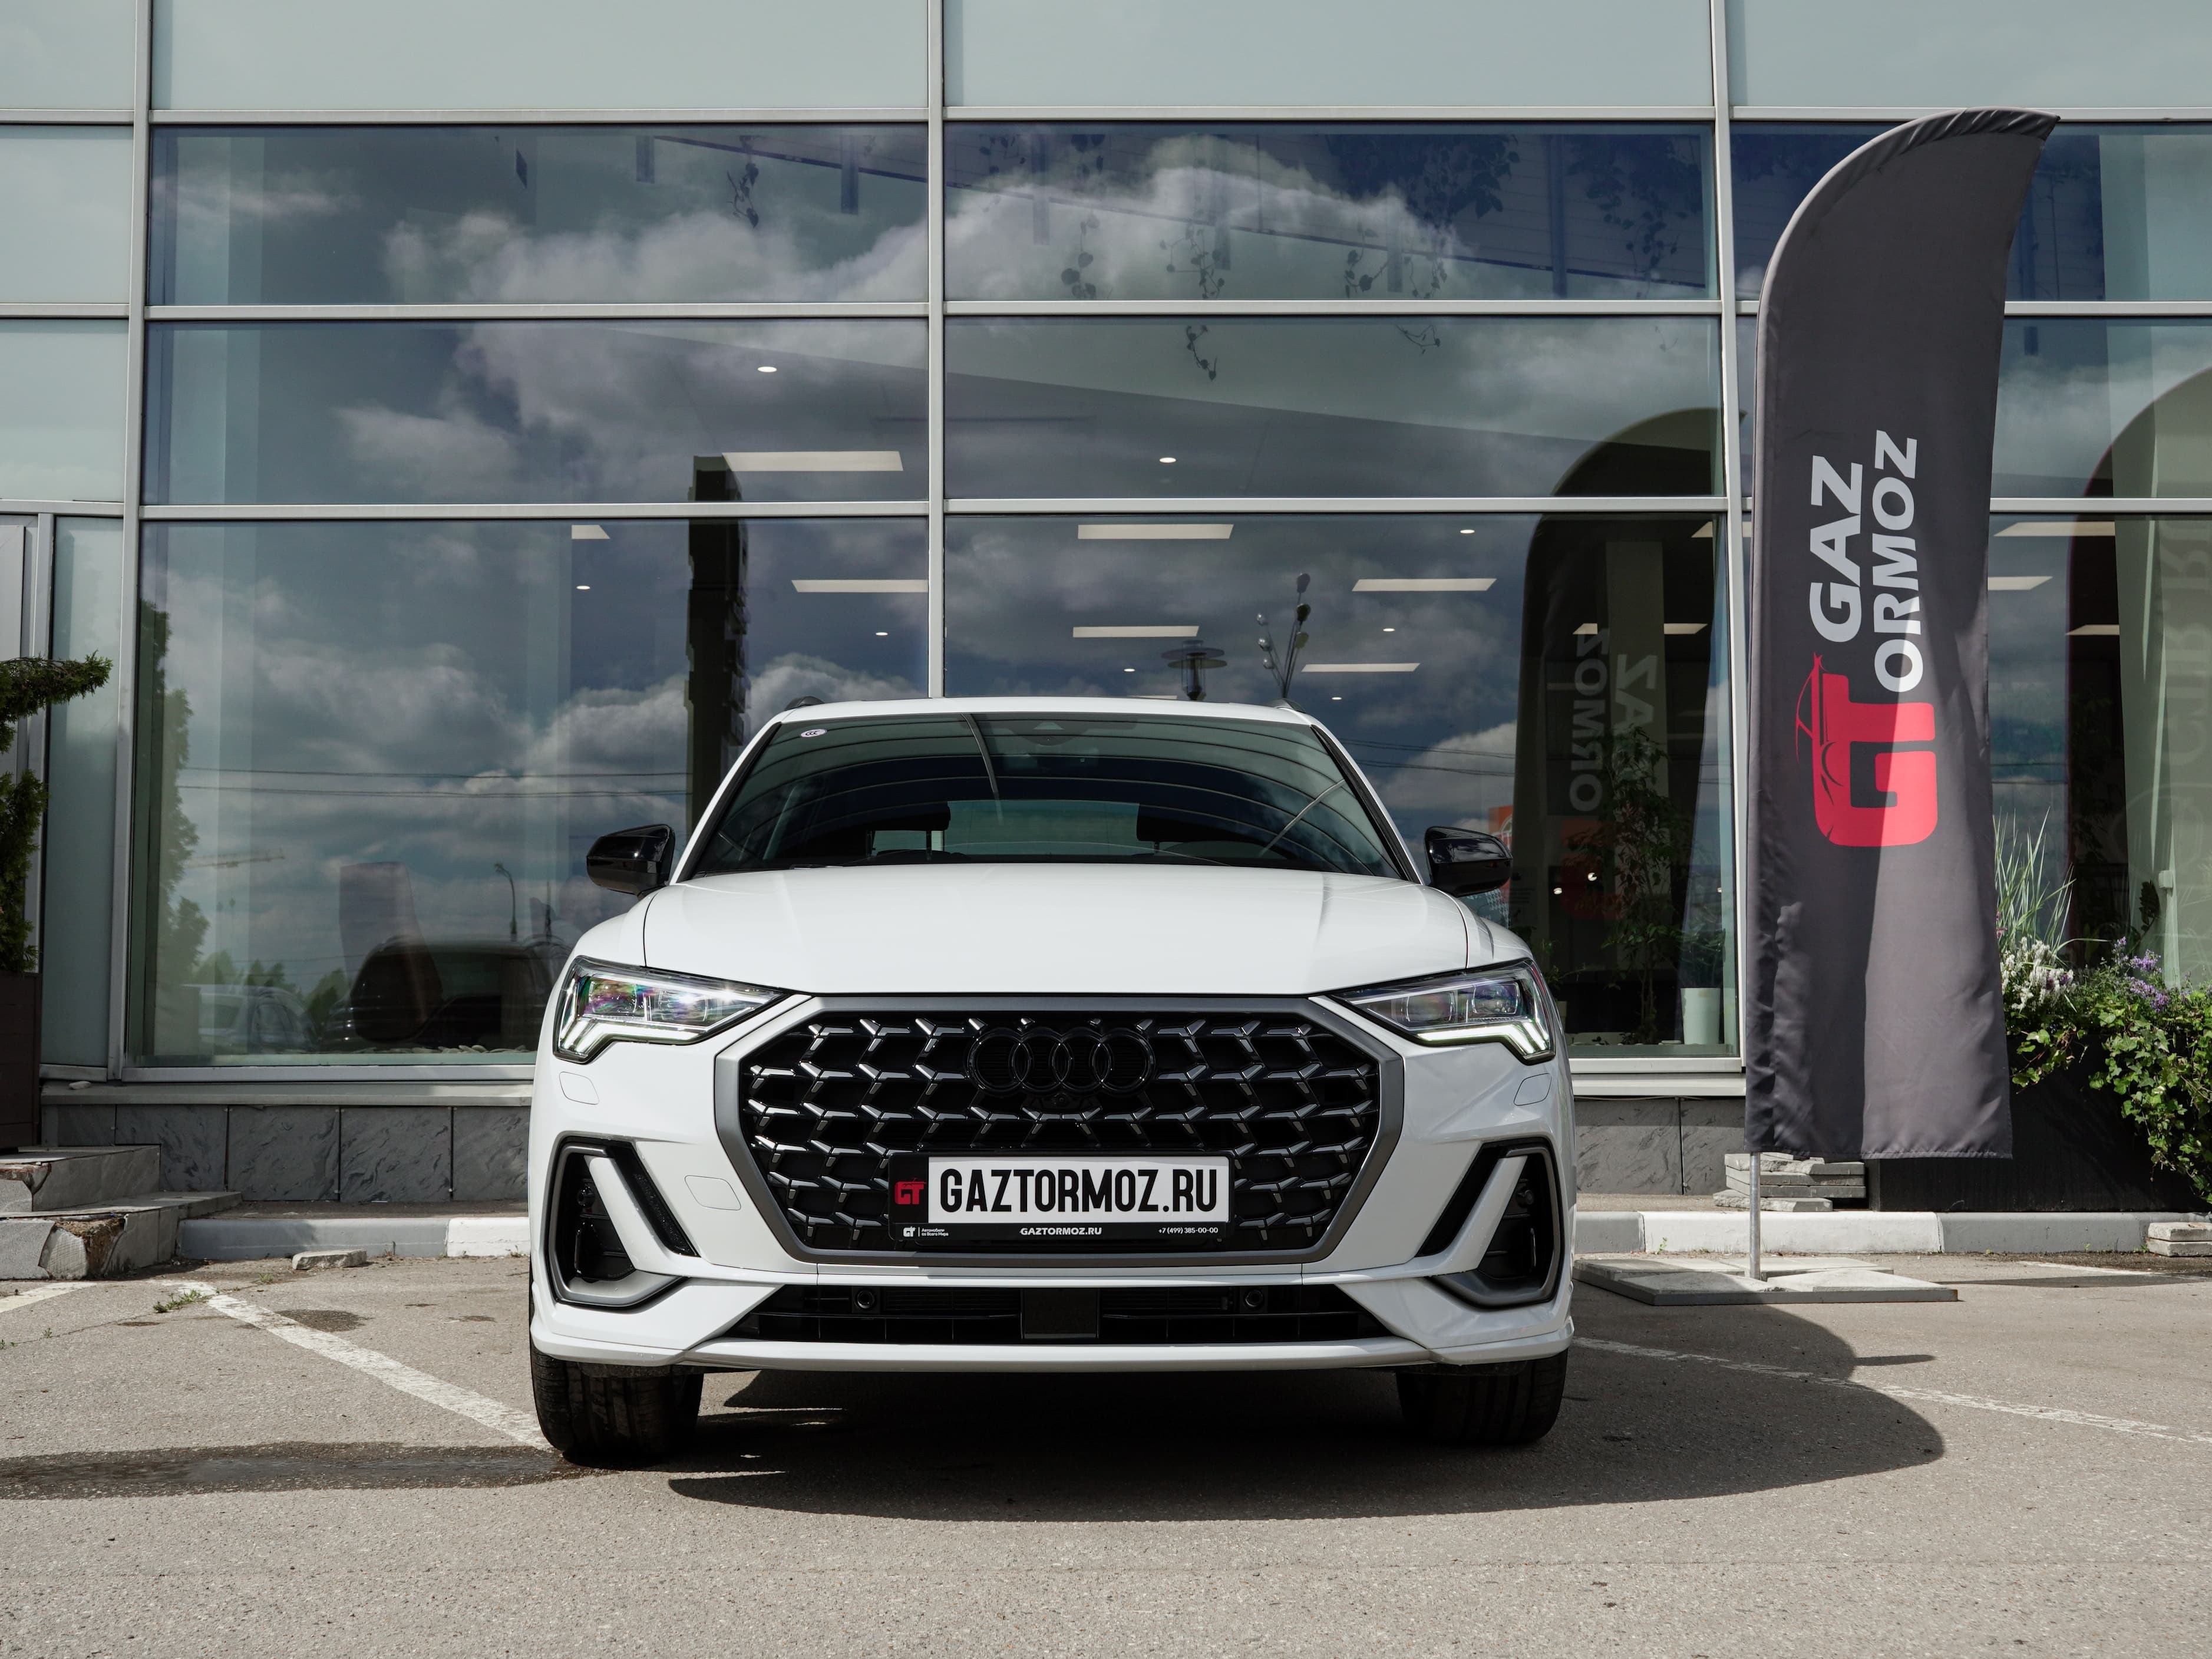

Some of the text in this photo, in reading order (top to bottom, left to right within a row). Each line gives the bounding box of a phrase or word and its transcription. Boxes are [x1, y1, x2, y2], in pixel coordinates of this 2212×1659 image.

[1809, 455, 1863, 643] GAZ
[1871, 430, 1924, 692] ORMOZ
[1807, 663, 1938, 847] GT
[894, 1180, 925, 1205] GT
[903, 1226, 916, 1237] GT
[940, 1169, 1217, 1212] GAZTORMOZ.RU
